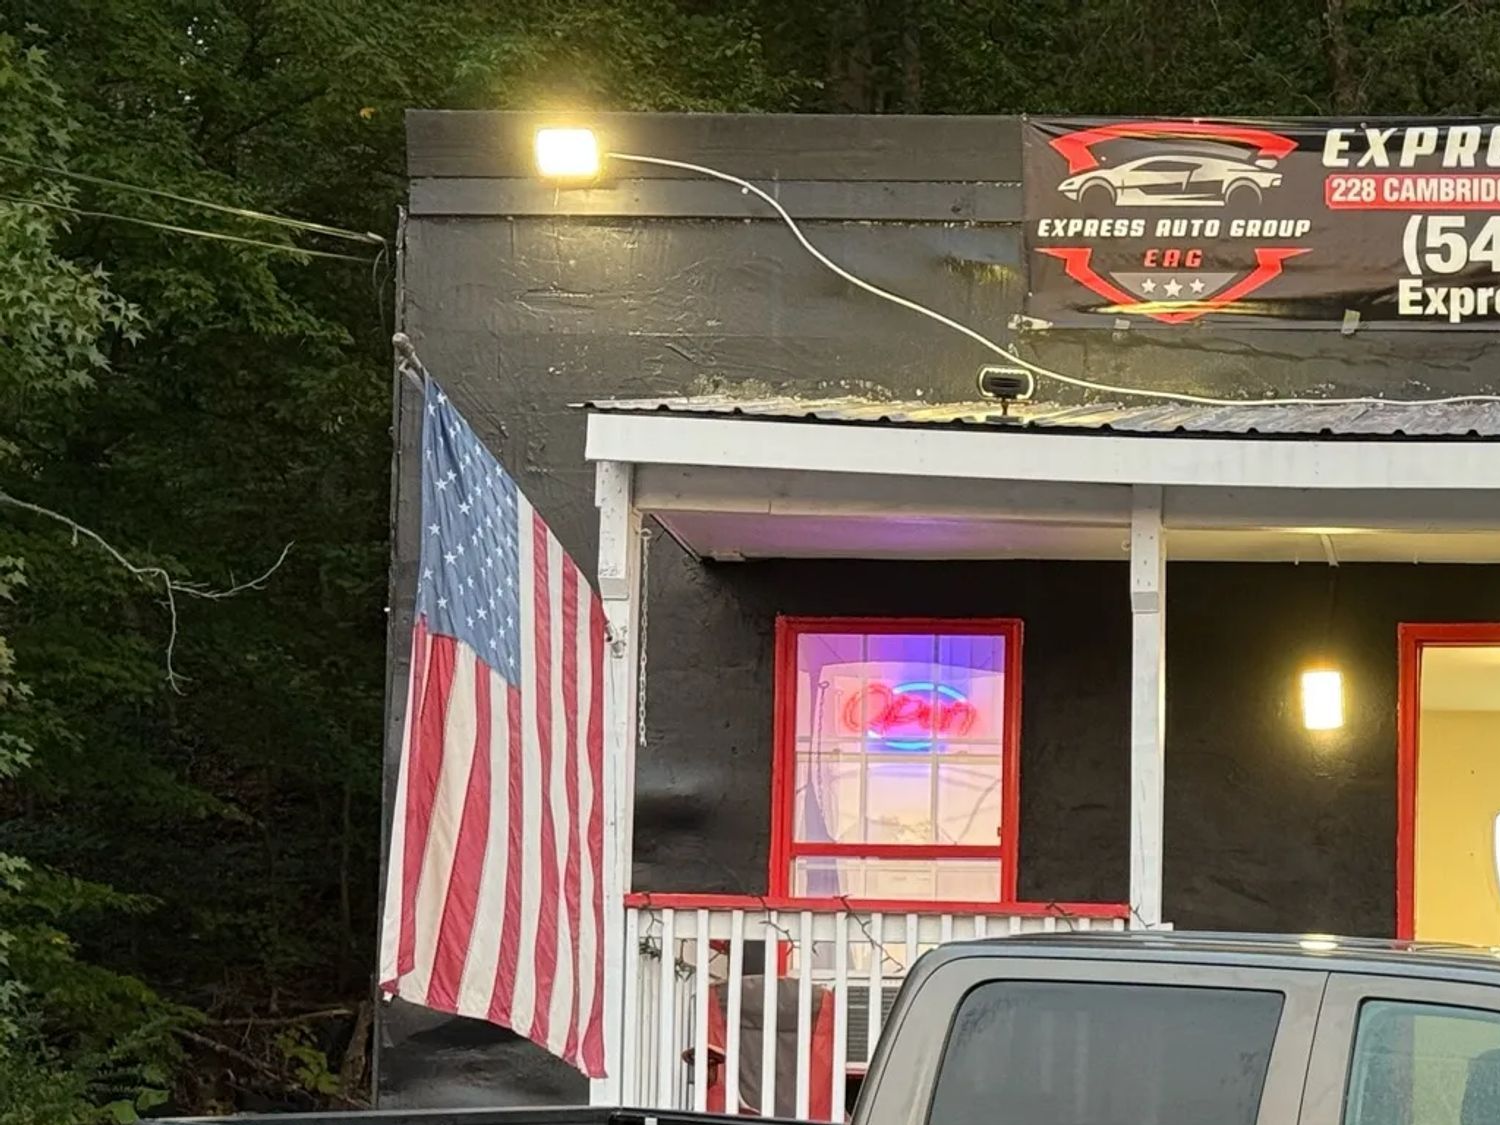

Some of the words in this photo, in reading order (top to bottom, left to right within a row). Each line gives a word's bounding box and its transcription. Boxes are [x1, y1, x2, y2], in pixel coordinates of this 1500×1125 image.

[1331, 177, 1375, 203] 228
[1037, 219, 1145, 239] EXPRESS
[1155, 219, 1220, 238] AUTO
[1230, 219, 1311, 238] GROUP
[1144, 249, 1203, 268] EAG
